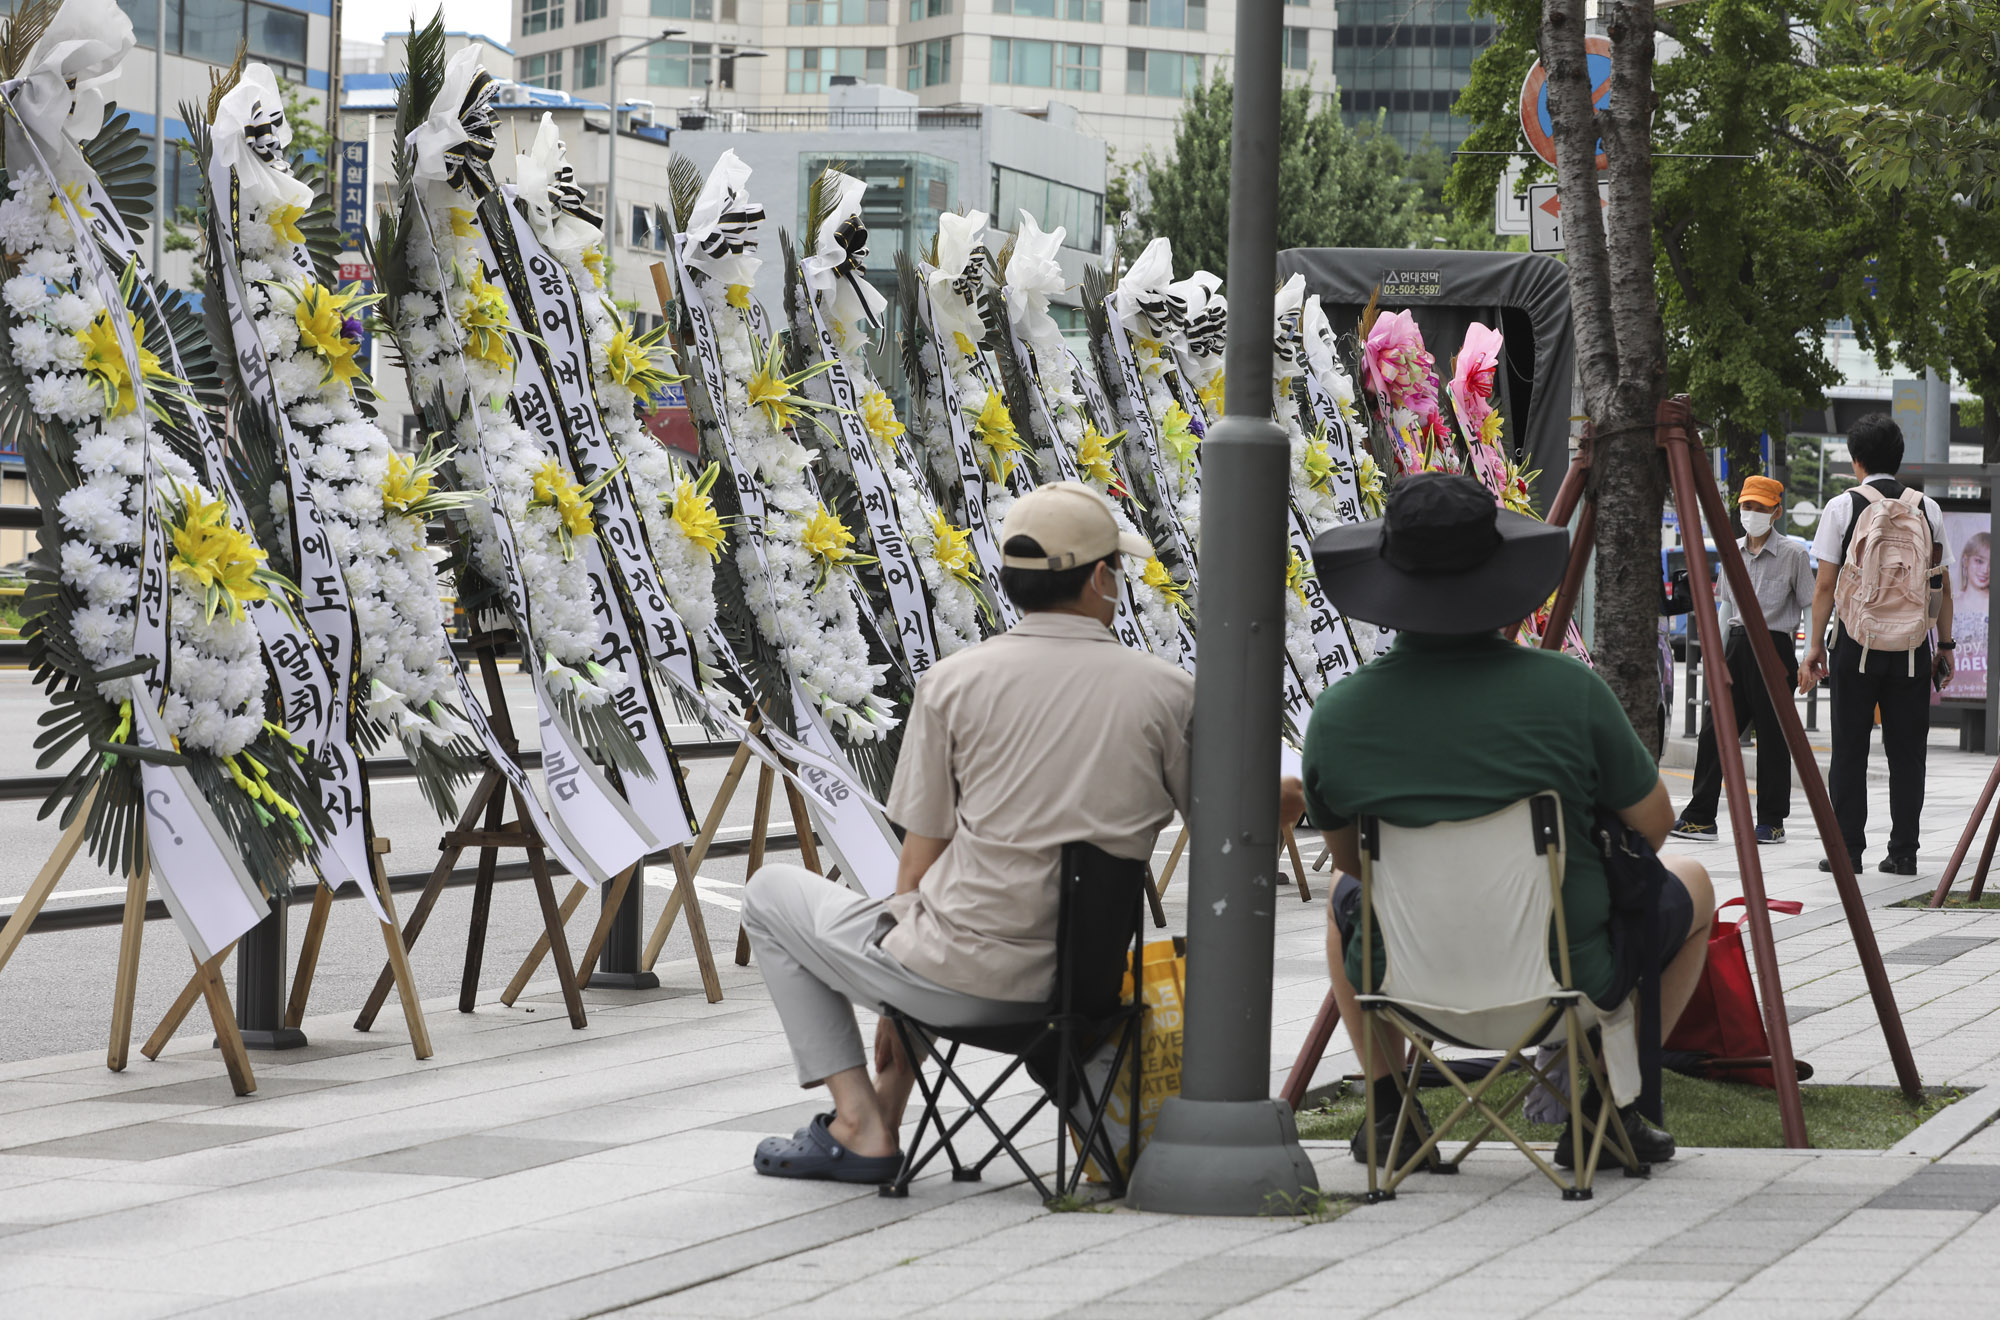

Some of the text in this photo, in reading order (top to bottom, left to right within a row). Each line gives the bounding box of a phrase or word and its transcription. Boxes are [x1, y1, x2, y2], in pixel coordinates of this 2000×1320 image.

[345, 146, 363, 225] 태원치과
[1384, 284, 1440, 295] 02-502-5597
[529, 252, 600, 447] 잃어버린
[865, 485, 914, 594] 찌들어
[1121, 1073, 1182, 1097] WATE
